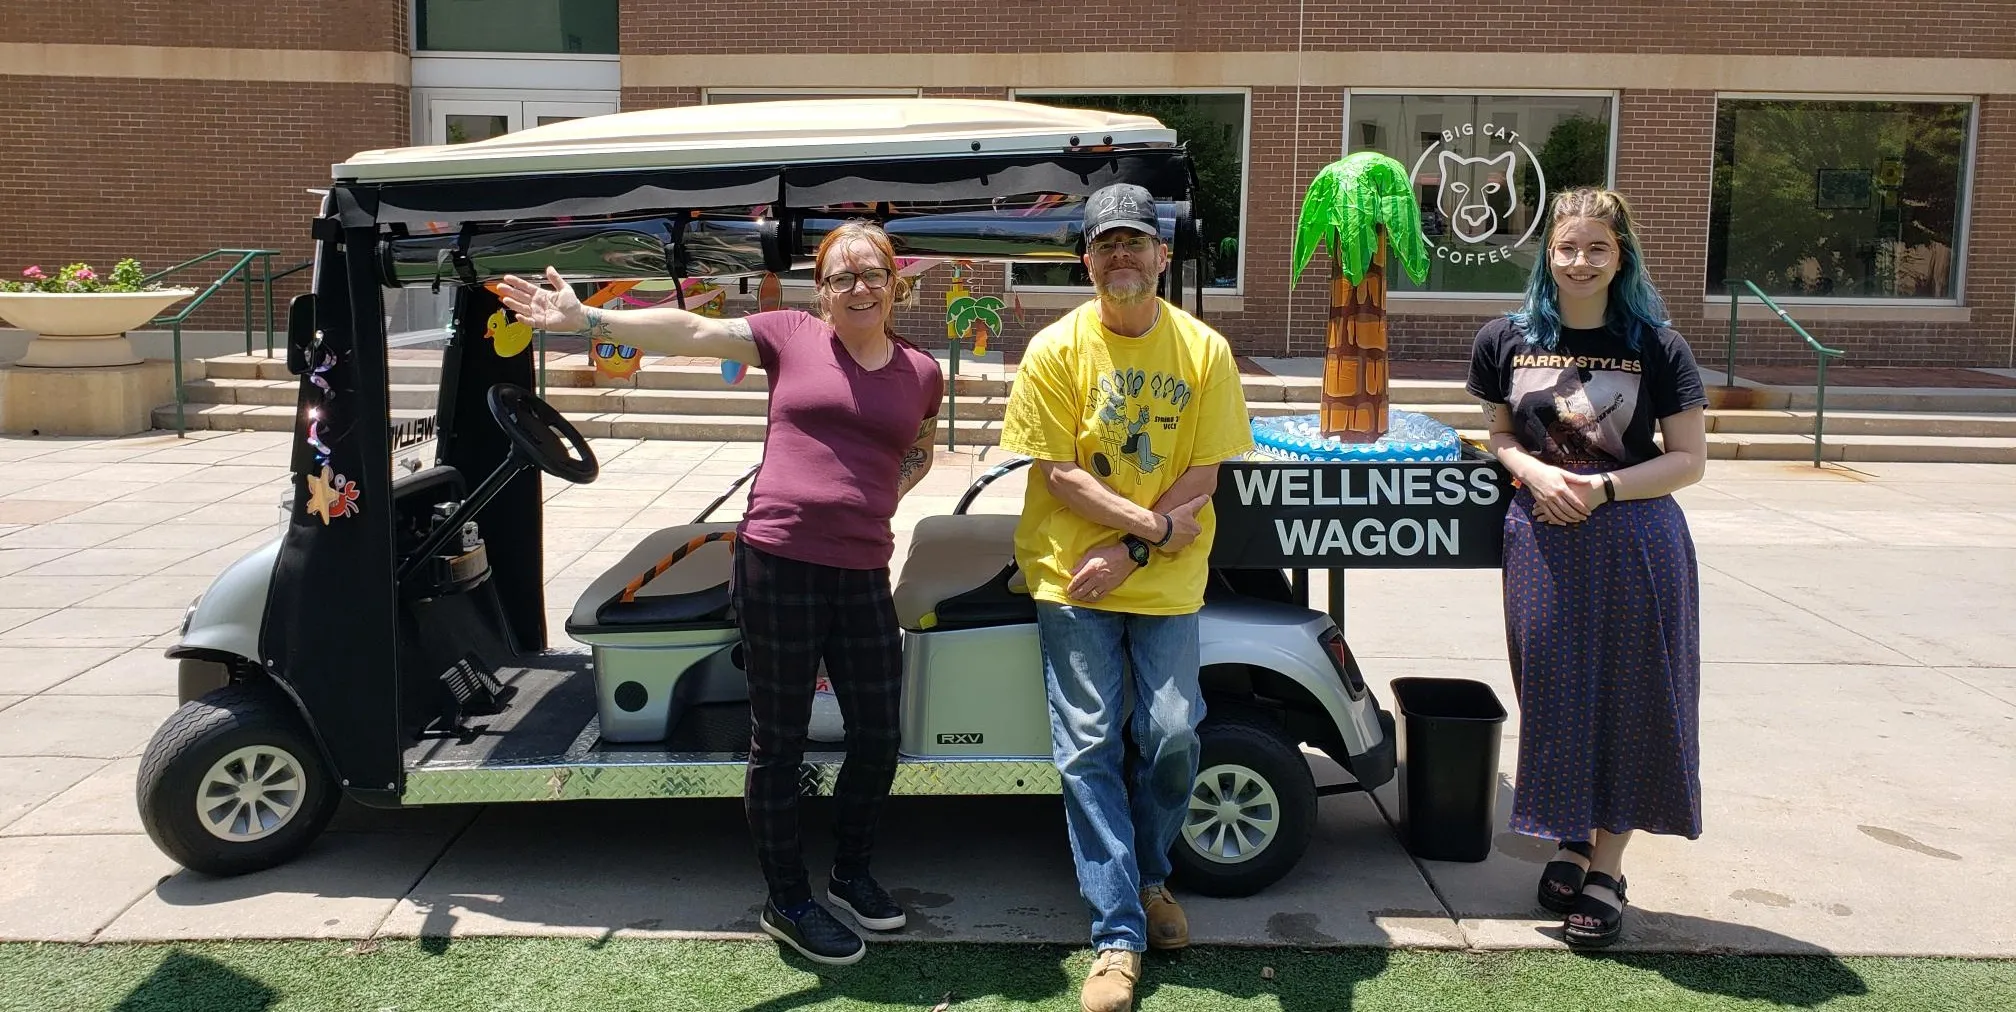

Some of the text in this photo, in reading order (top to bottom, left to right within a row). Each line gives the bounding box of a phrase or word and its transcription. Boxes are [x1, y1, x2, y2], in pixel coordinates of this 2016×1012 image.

[1442, 123, 1519, 143] BIG CAT
[1436, 245, 1511, 265] COFFEE
[1512, 354, 1642, 372] HARRY STYLES
[1233, 467, 1500, 506] WELLNESS
[1275, 517, 1459, 556] WAGON
[941, 734, 980, 743] RXV
